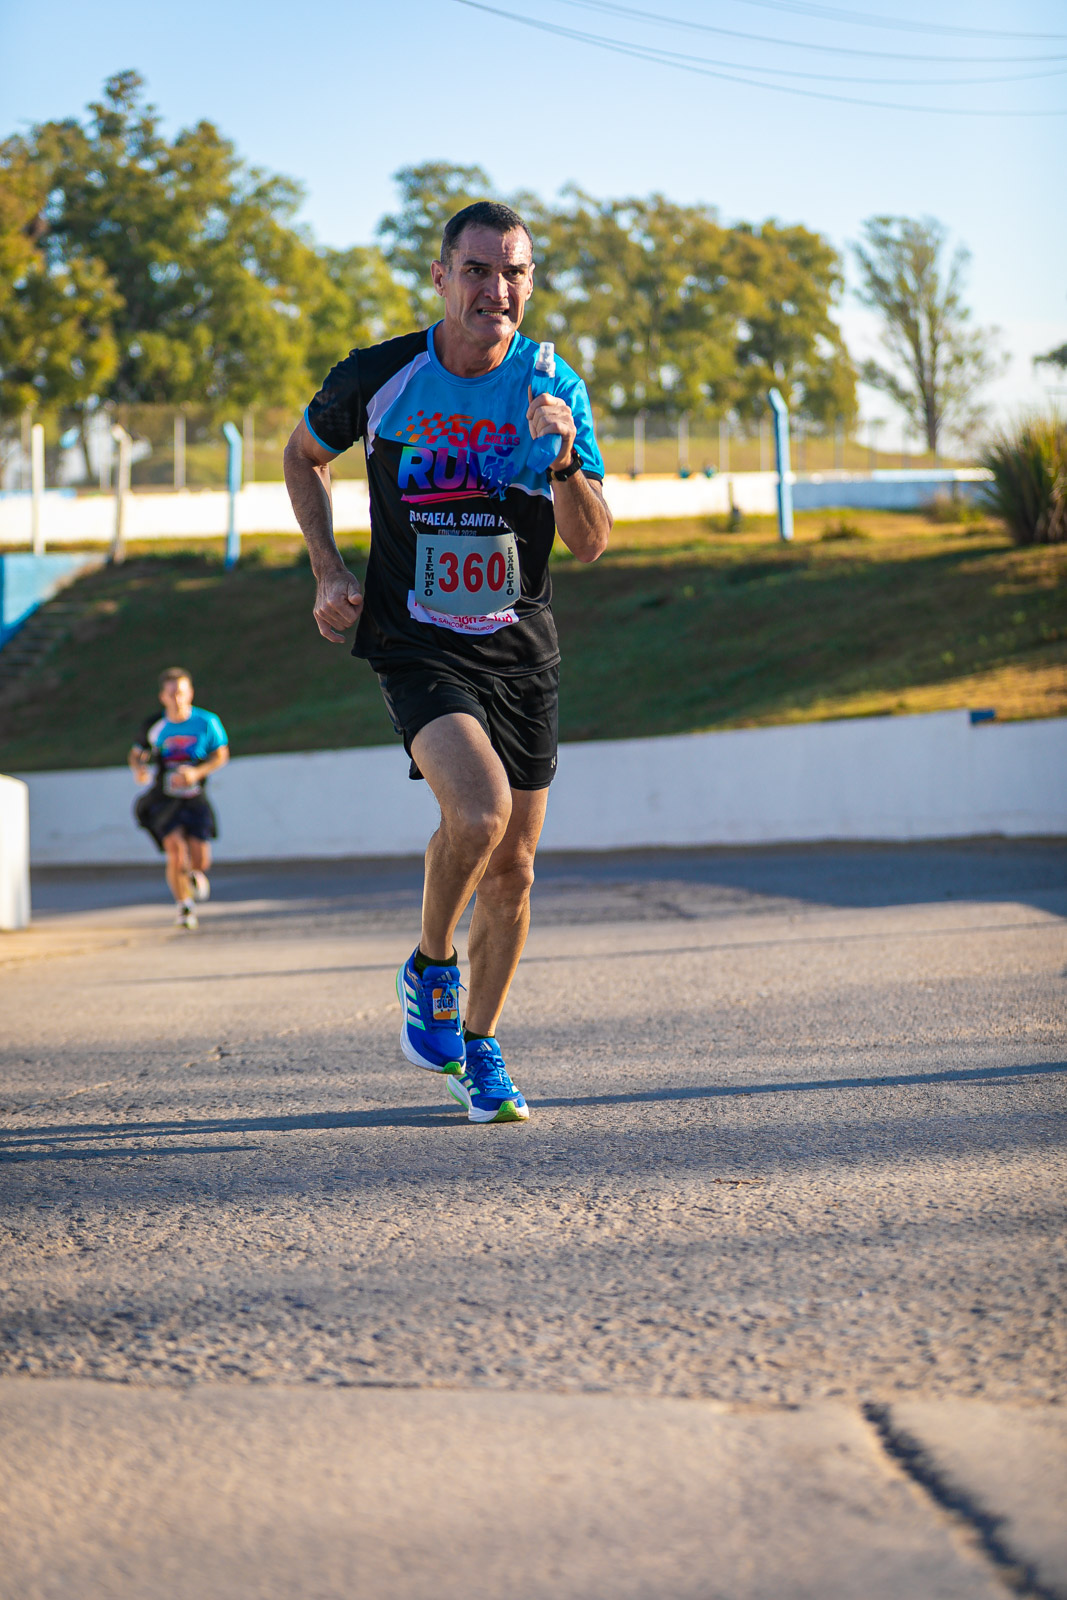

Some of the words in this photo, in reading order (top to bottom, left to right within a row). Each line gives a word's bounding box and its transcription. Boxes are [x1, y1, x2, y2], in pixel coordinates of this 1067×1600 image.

[409, 510, 457, 527] RAFAELA,
[460, 513, 495, 527] SANTA
[424, 547, 435, 597] TIEMPO
[438, 551, 506, 593] 360
[506, 547, 515, 596] EXACTO
